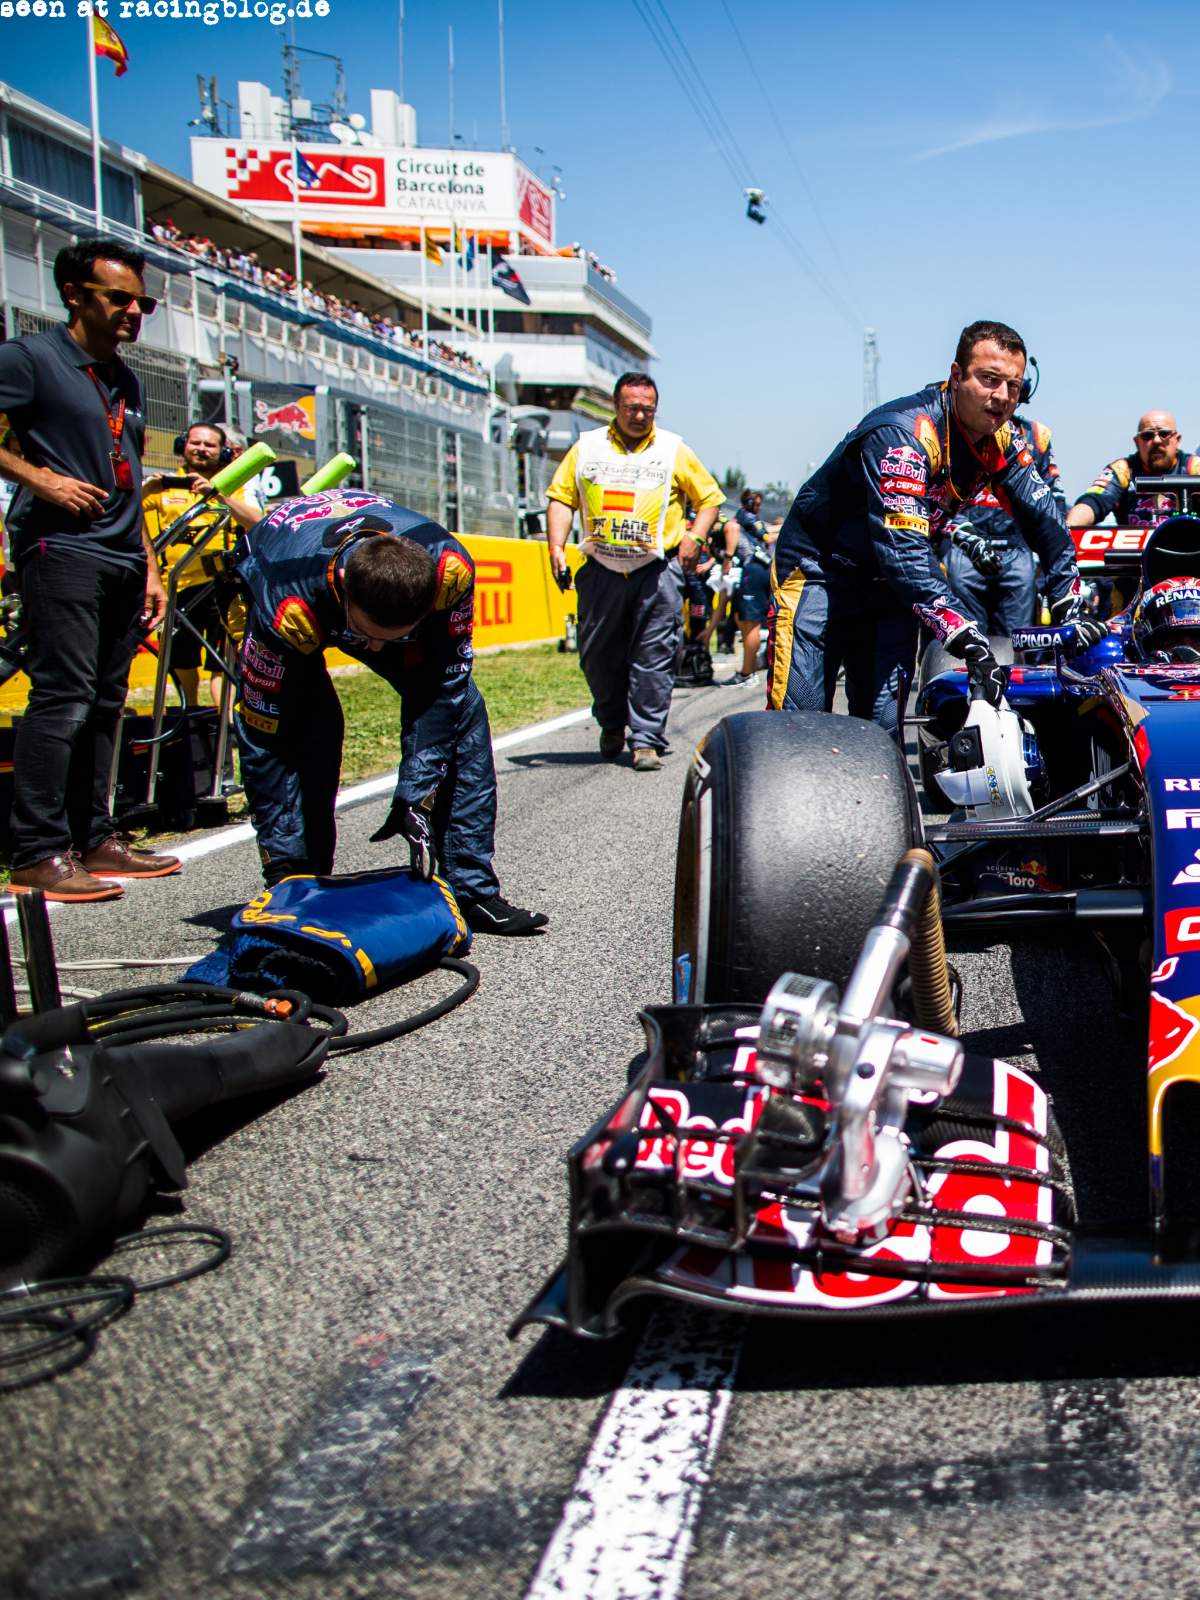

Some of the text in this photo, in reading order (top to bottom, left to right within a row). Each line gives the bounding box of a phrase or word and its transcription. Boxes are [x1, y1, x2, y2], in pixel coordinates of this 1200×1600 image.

[397, 159, 485, 176] Circuit de
[397, 178, 485, 195] Barcelona
[397, 195, 487, 211] CATALUNYA
[881, 460, 927, 483] Red Bull
[895, 480, 923, 492] CEPSA
[1011, 632, 1064, 649] SAPINDA
[1006, 871, 1035, 888] Toro
